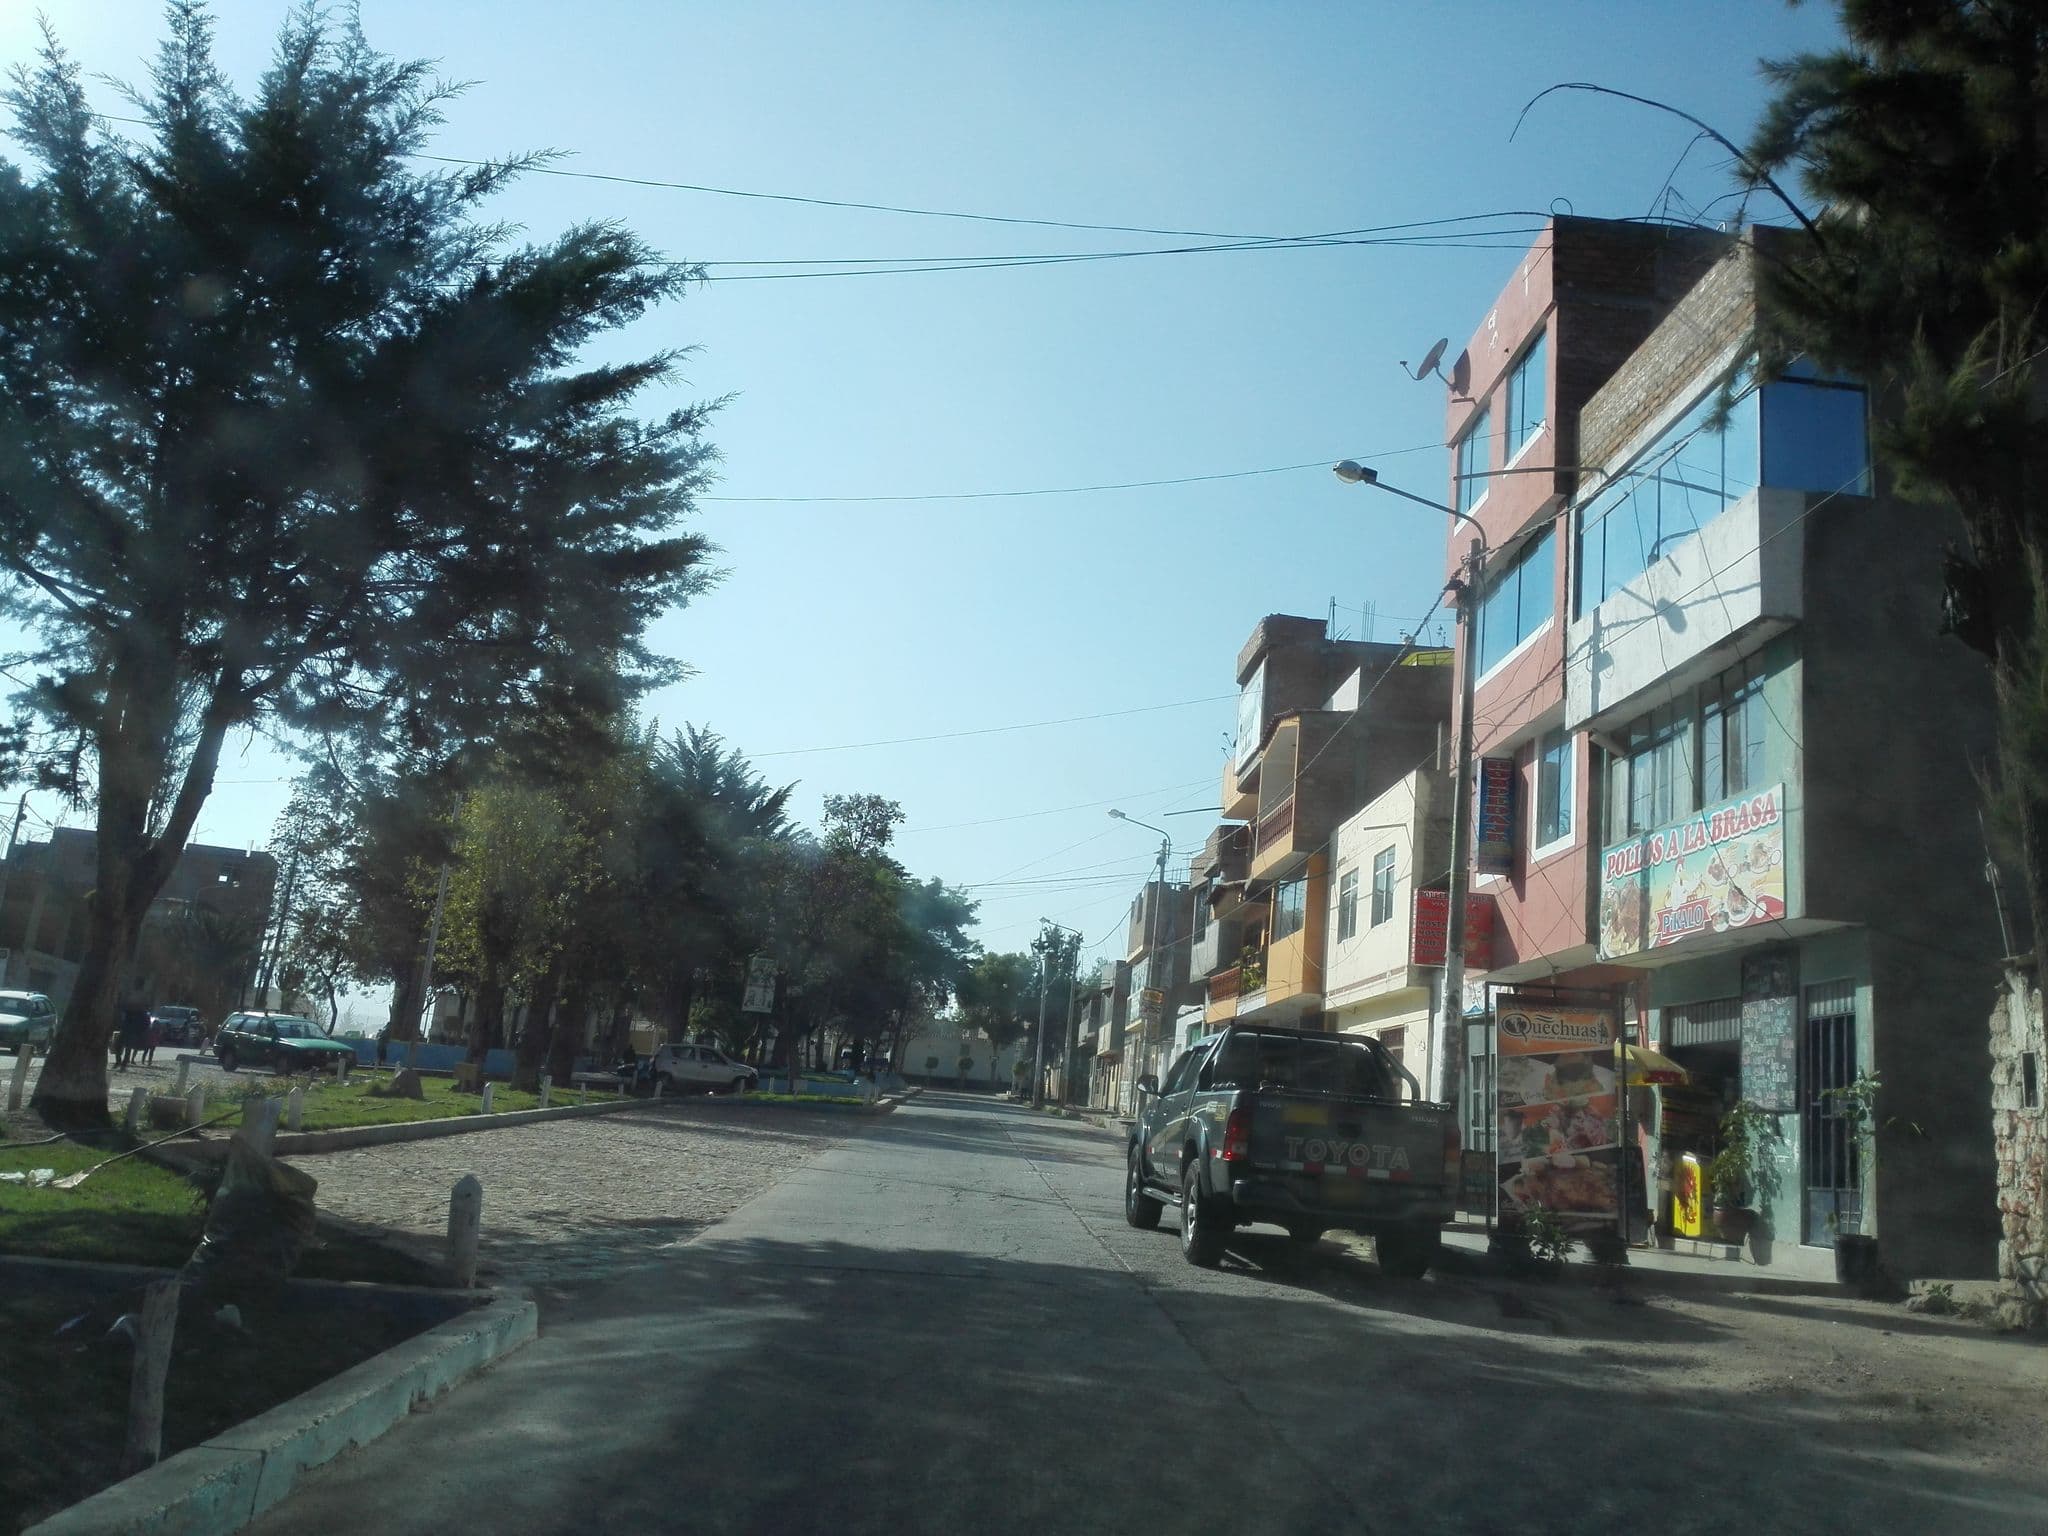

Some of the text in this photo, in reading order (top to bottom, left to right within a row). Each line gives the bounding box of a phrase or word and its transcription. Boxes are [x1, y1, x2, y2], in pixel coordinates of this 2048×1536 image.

[1606, 792, 1778, 882] POLLOS A LA BRASA
[1501, 1012, 1597, 1043] Quechuas
[1284, 1135, 1411, 1170] TOYOTA
